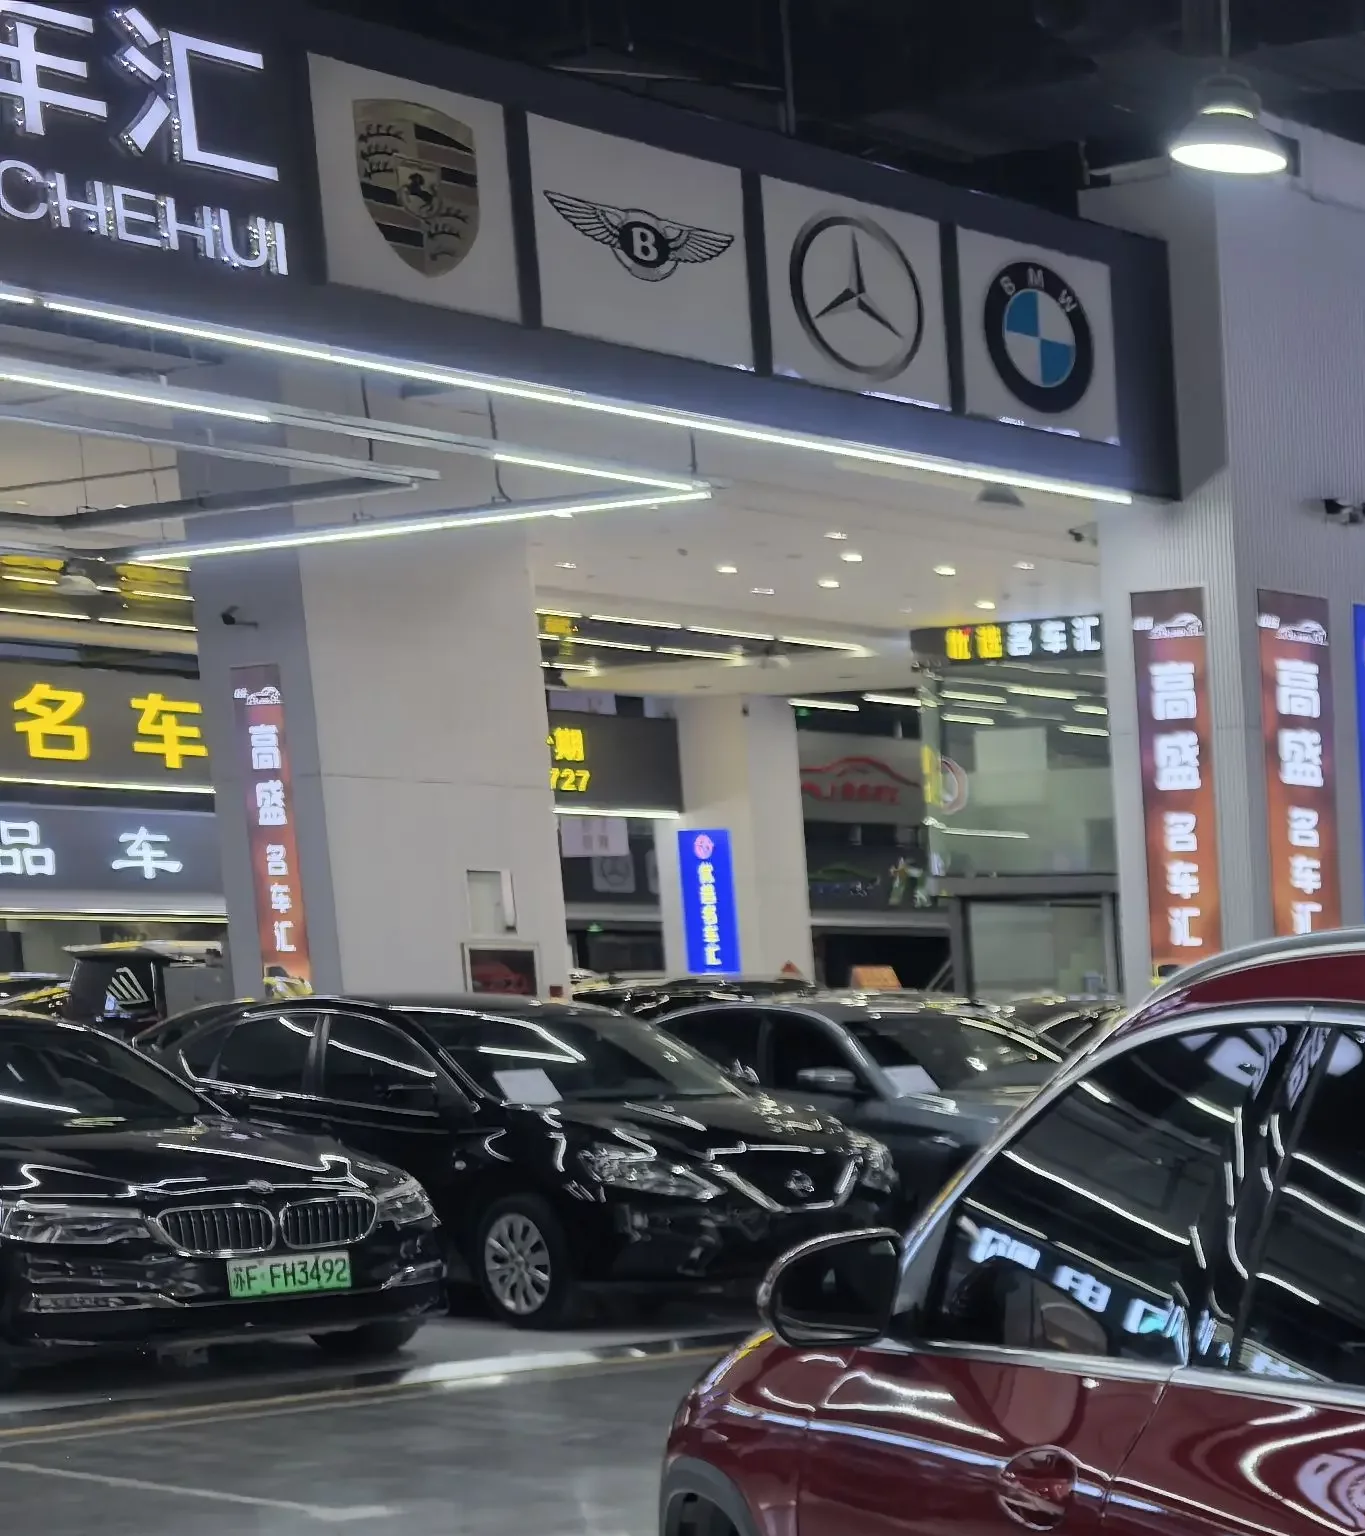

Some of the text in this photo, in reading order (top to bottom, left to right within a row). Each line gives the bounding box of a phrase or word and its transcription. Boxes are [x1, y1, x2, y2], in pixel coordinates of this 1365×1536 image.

[0, 160, 288, 275] CHEHUI
[1000, 266, 1076, 312] BMW
[13, 683, 208, 769] 名车
[1149, 660, 1202, 947] 高盛名车汇
